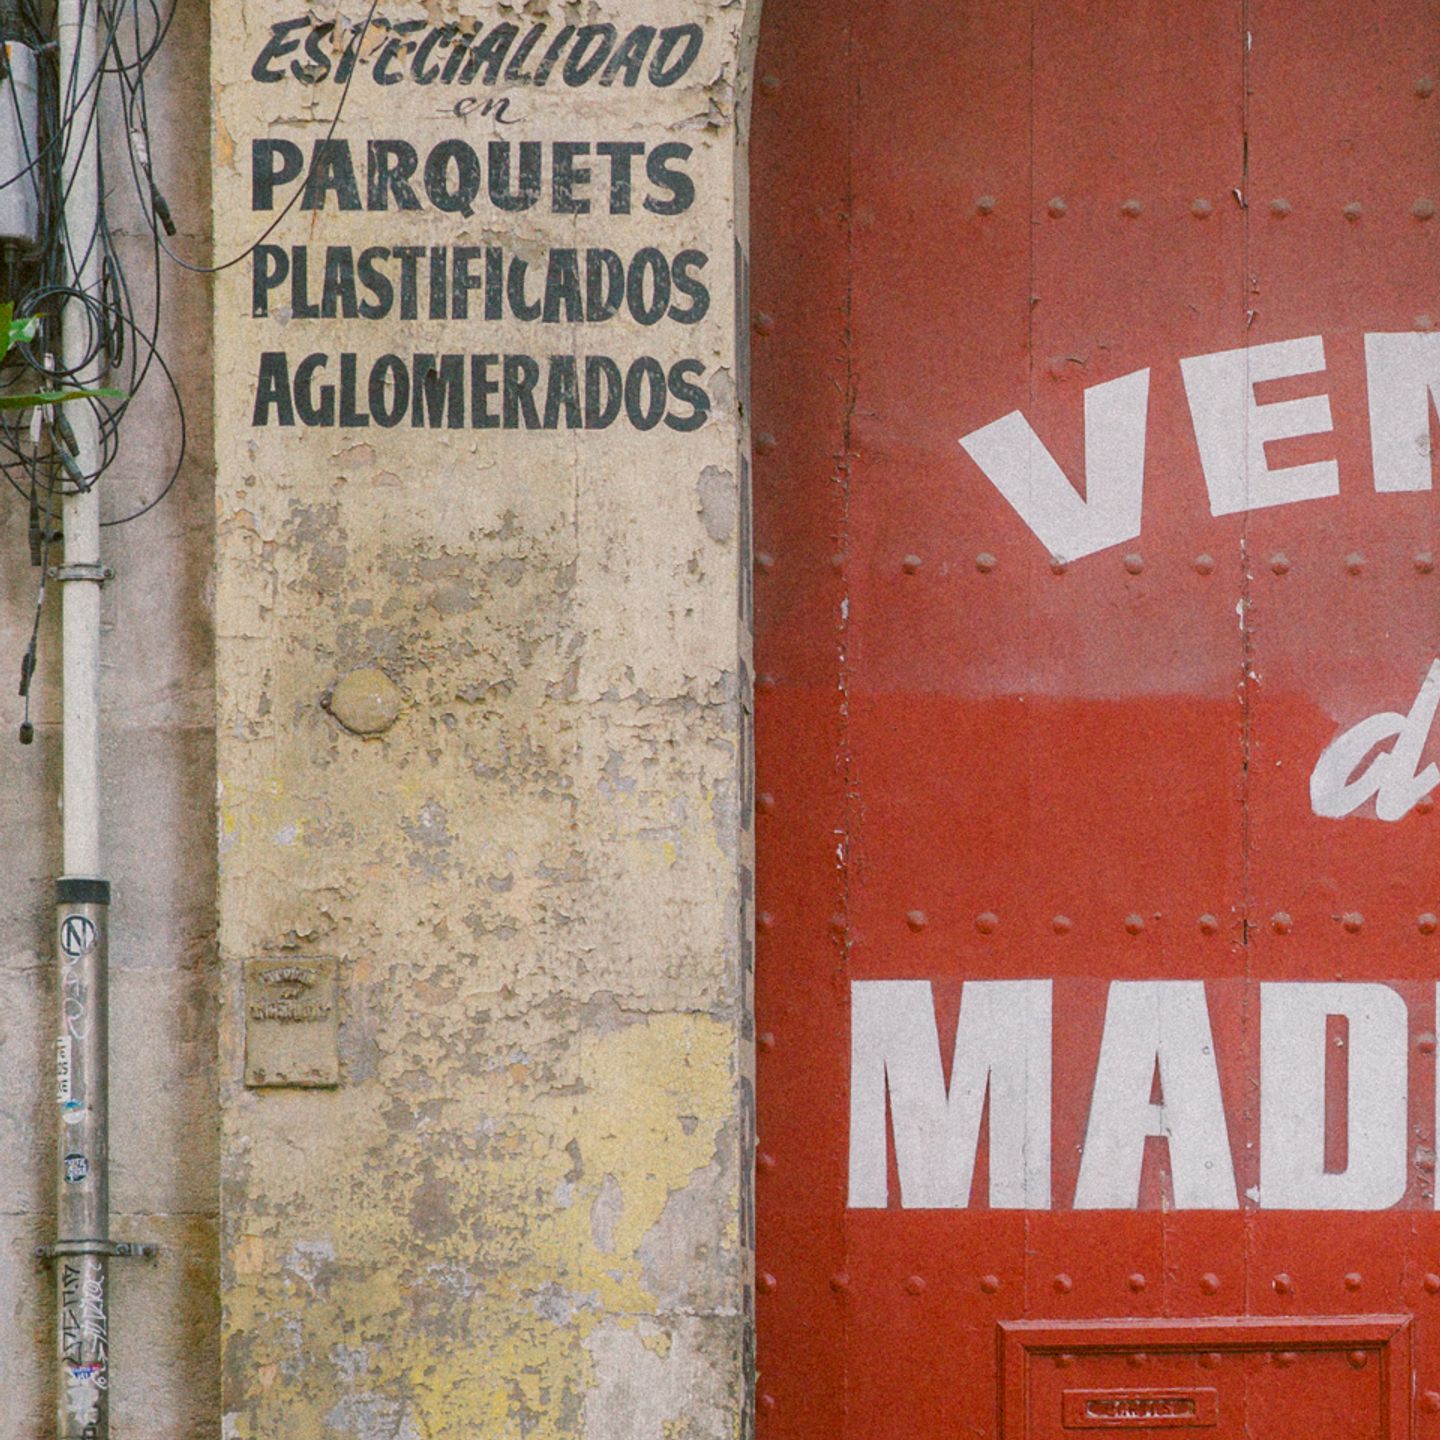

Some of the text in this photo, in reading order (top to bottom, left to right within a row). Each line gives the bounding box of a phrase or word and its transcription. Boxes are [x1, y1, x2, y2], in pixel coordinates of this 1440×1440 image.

[251, 15, 704, 87] ESPECIALIDAD
[441, 96, 524, 125] en
[251, 138, 696, 218] PARQUETS
[251, 244, 711, 327] PLASTIFICADOS
[251, 351, 711, 433] AGLOMERADOS
